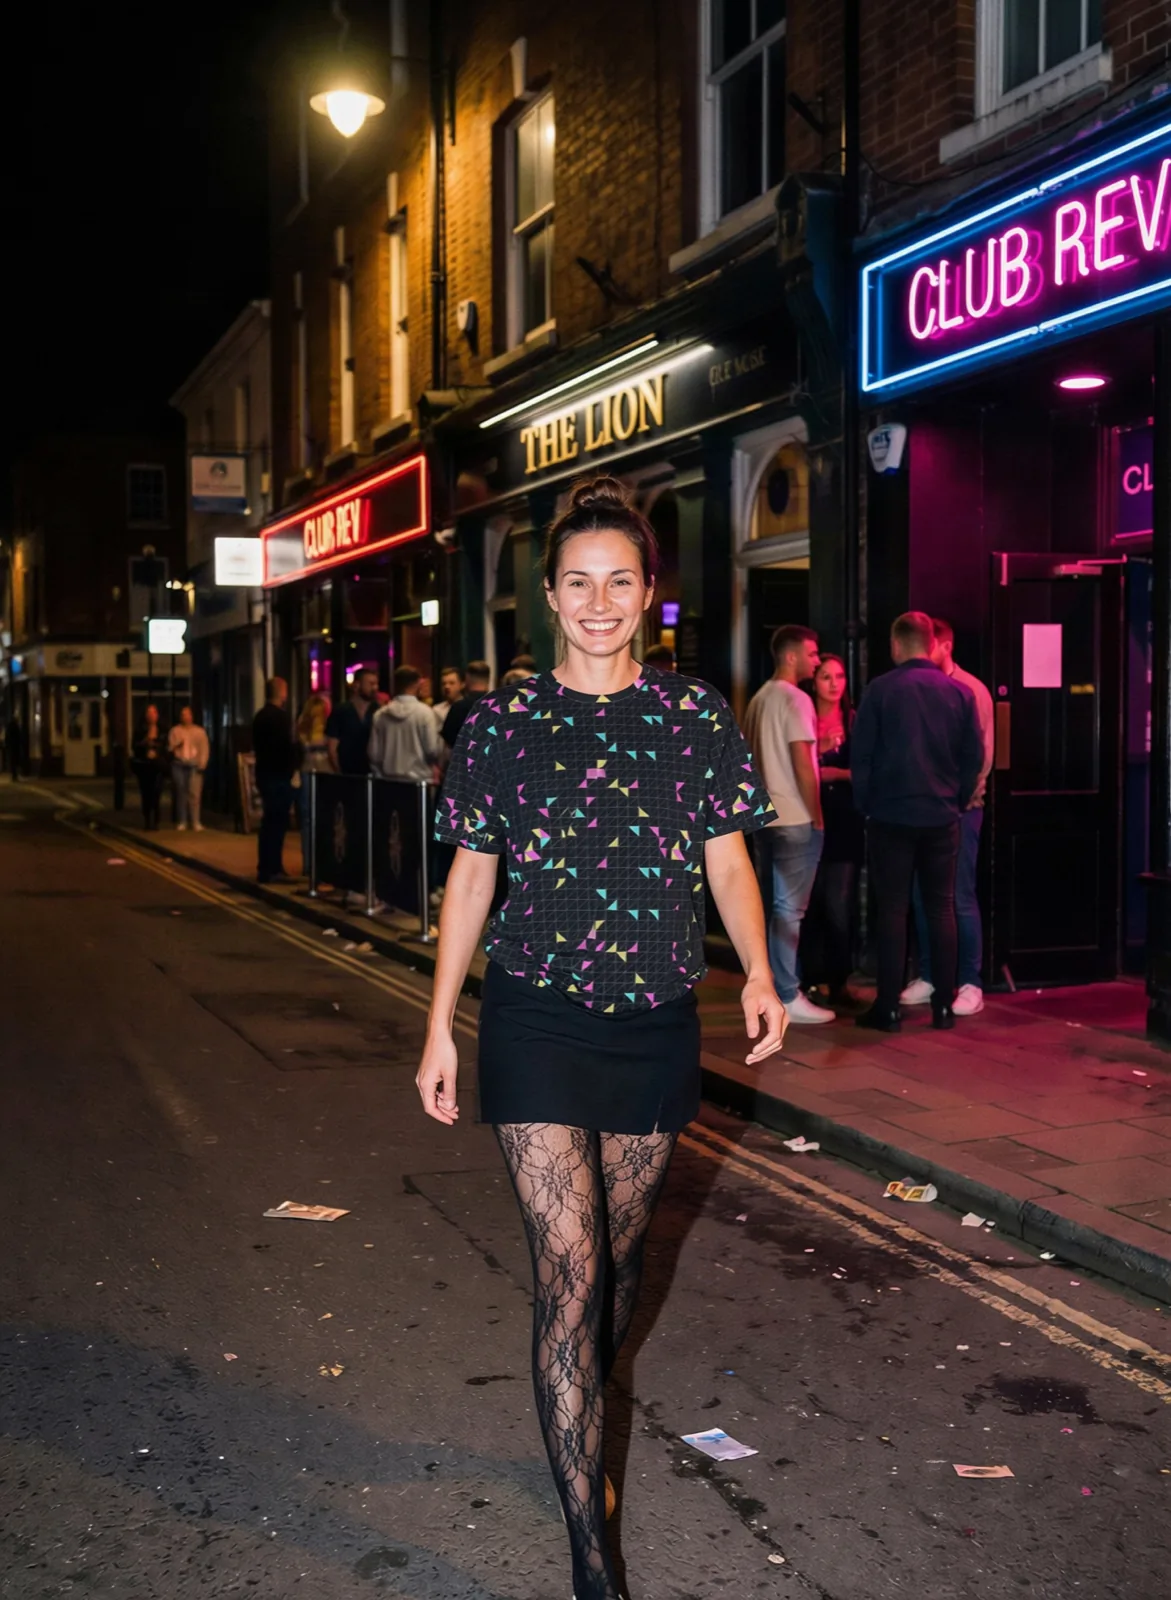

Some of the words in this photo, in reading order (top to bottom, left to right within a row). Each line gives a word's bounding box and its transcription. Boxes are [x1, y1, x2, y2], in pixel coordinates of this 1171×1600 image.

[908, 226, 1031, 340] CLUB
[1054, 158, 1171, 286] REV
[520, 415, 579, 474] THE
[584, 374, 667, 453] LION
